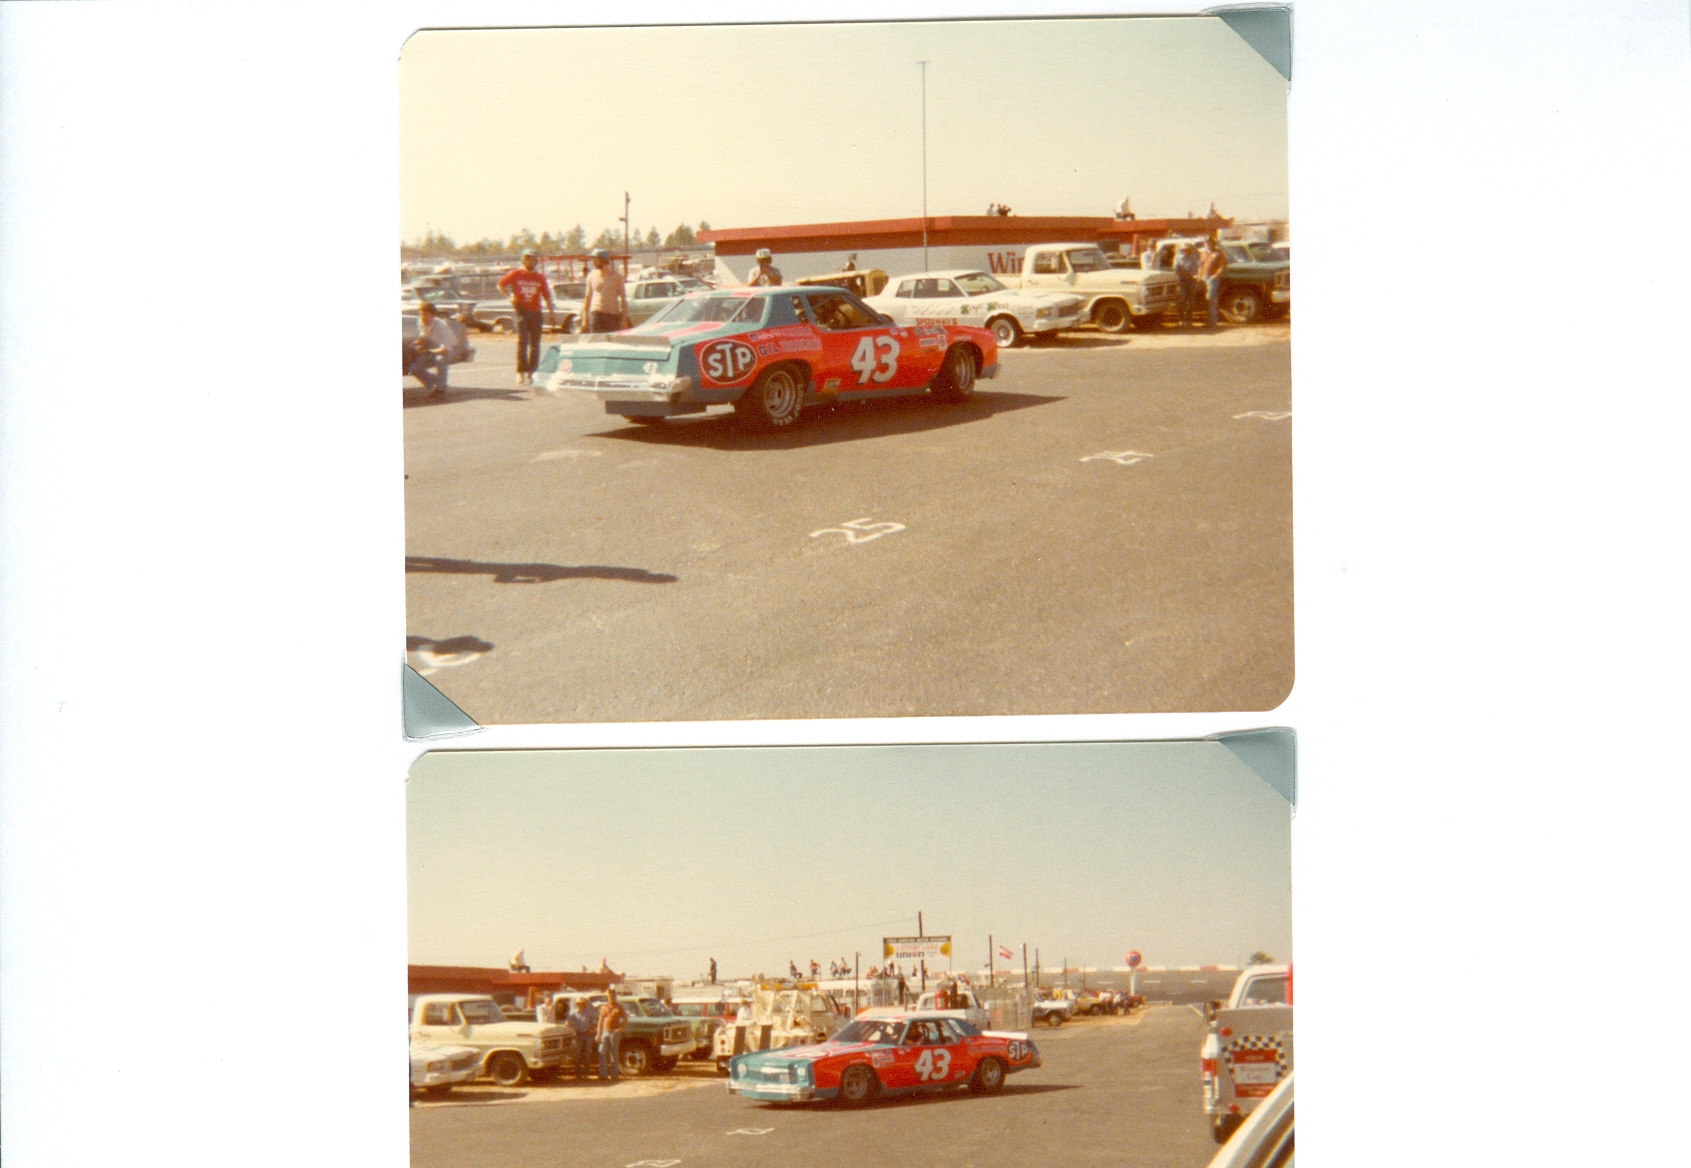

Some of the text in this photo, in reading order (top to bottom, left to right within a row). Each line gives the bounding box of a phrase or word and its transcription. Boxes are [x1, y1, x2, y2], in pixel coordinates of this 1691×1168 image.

[707, 343, 752, 378] STP
[850, 336, 900, 385] 43
[809, 517, 906, 543] 25
[914, 1048, 951, 1081] 43
[1009, 1041, 1029, 1061] STP
